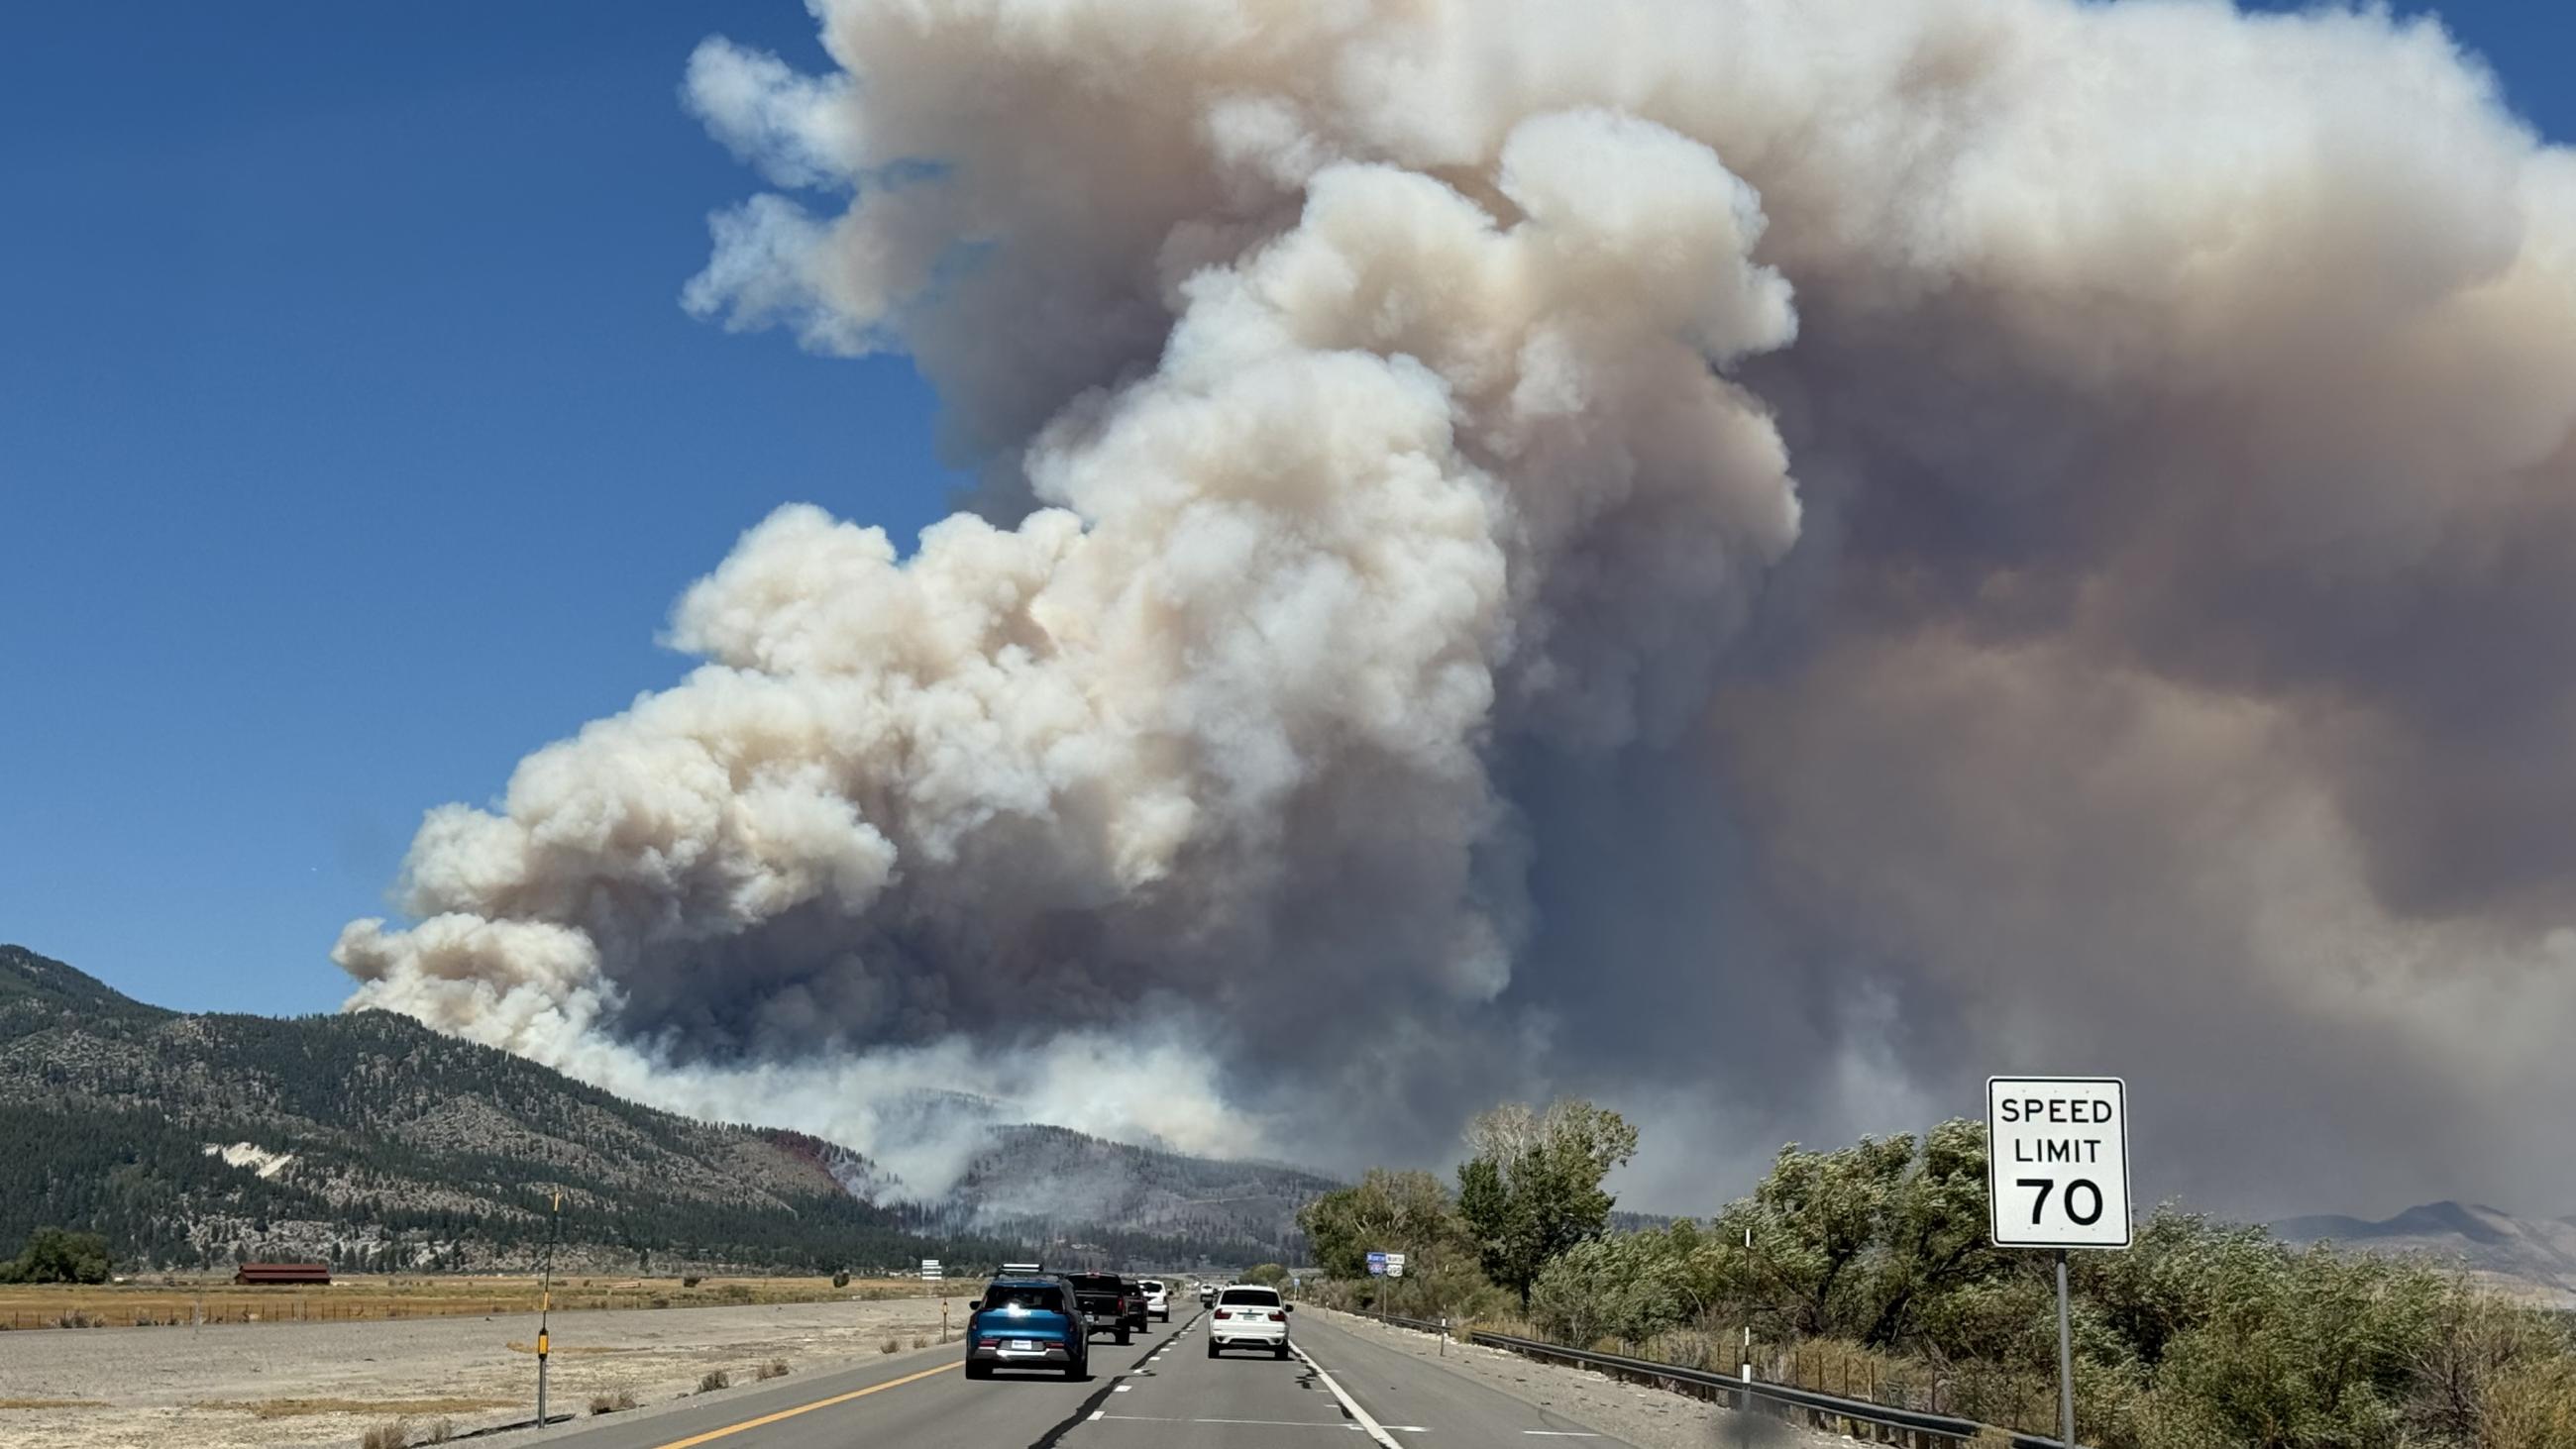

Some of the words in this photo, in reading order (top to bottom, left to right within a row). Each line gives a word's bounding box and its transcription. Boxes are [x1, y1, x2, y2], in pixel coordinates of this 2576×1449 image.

[2001, 1098, 2112, 1123] SPEED
[2015, 1138, 2101, 1164] LIMIT
[2016, 1179, 2103, 1226] 70
